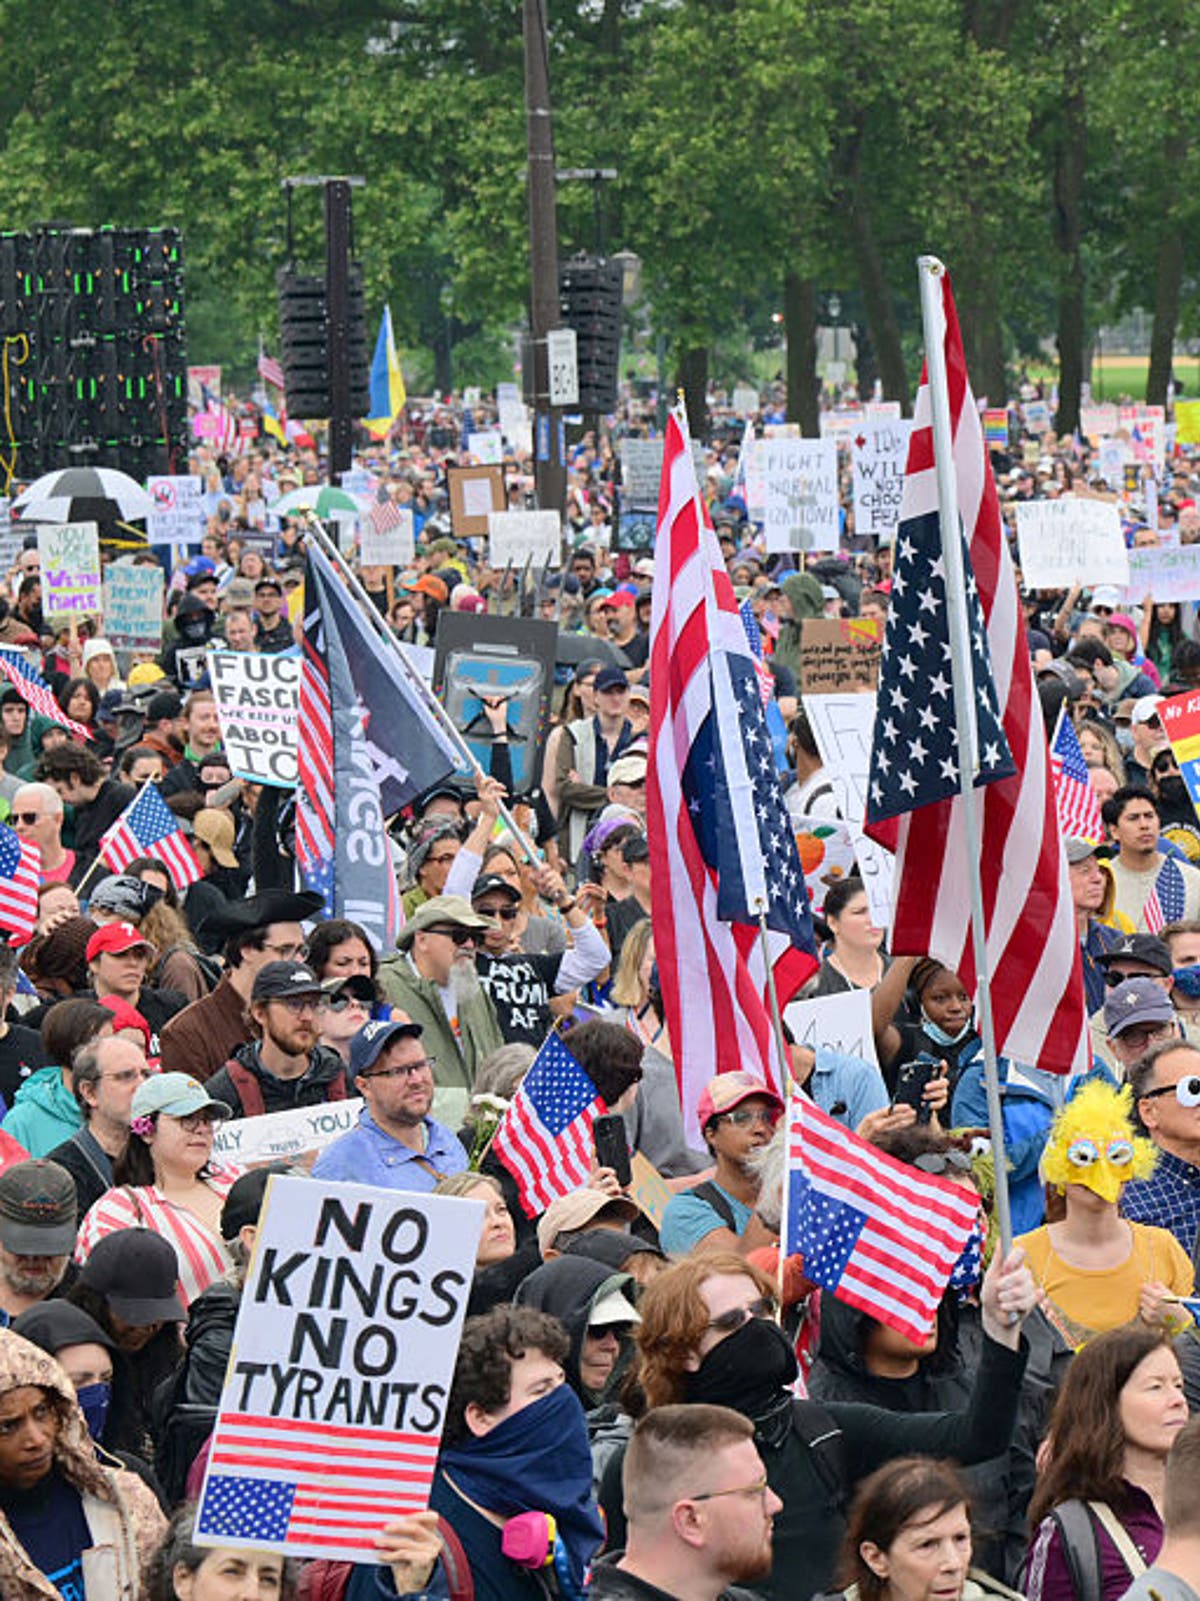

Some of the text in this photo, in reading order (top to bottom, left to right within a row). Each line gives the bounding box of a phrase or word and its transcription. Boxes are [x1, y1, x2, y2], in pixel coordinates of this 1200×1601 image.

[768, 453, 824, 471] FIGHT
[858, 461, 905, 479] WIL
[860, 493, 902, 508] CHOO
[871, 510, 900, 529] FEA
[212, 653, 298, 684] FUC
[218, 684, 298, 709] FASCI
[1164, 703, 1183, 722] No
[225, 723, 298, 747] ABOL
[230, 742, 298, 782] IC
[510, 1007, 540, 1030] AF
[306, 1111, 352, 1136] YOU
[212, 1129, 244, 1154] NLY
[313, 1197, 429, 1264] NO
[254, 1247, 466, 1327] KINGS
[288, 1312, 398, 1377] NO
[235, 1361, 446, 1433] TYRANTS
